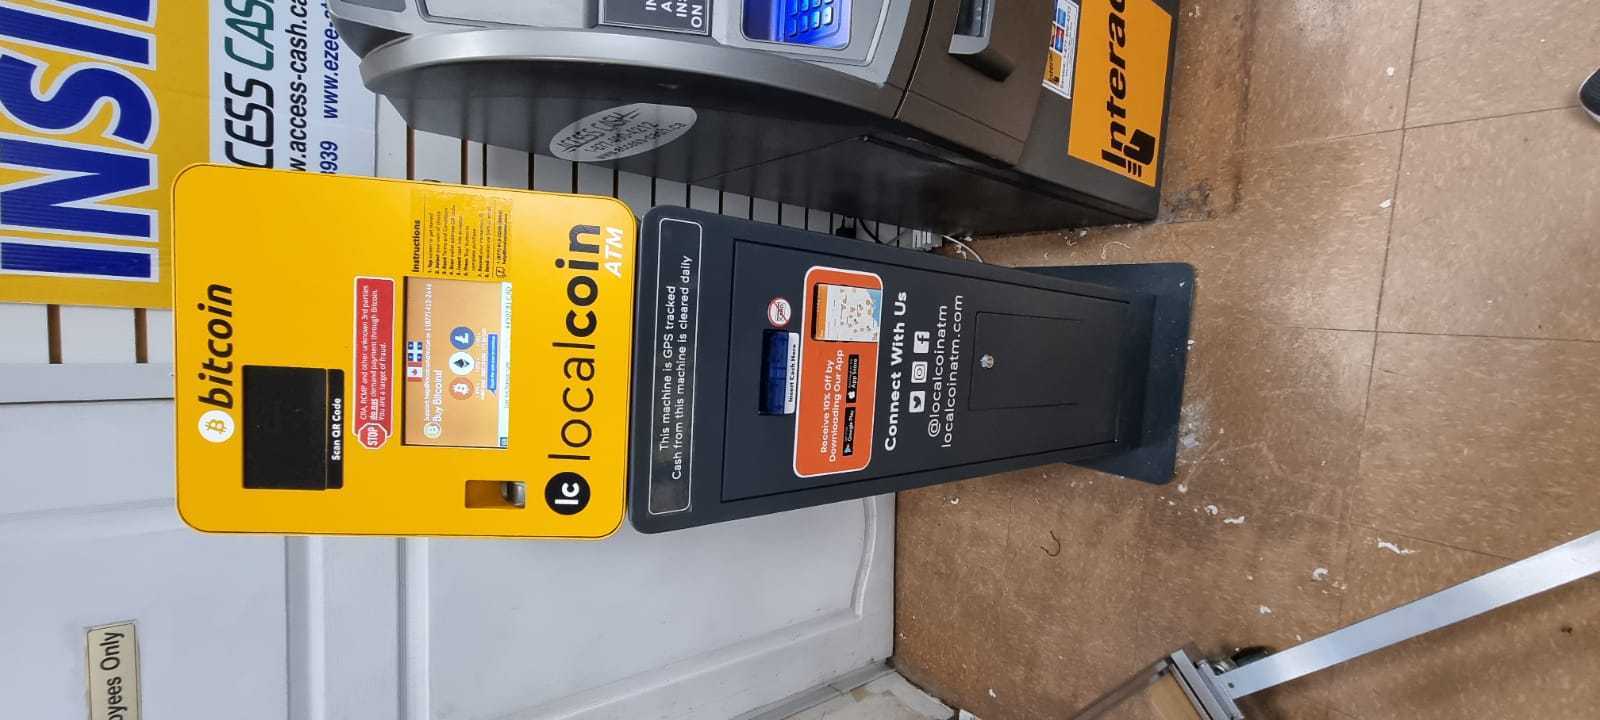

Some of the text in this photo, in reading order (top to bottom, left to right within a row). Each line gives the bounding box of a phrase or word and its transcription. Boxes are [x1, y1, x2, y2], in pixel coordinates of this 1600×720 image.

[676, 0, 688, 17] IN
[691, 4, 703, 28] ON
[224, 0, 274, 71] CAS
[0, 0, 158, 282] INSI
[412, 220, 420, 272] Instructions
[604, 226, 624, 278] ATM
[362, 286, 370, 307] parties
[198, 283, 233, 409] bitcoin
[370, 314, 379, 340] through
[379, 342, 387, 362] fraud.
[548, 224, 600, 461] localcoin
[370, 341, 379, 370] payment
[380, 371, 388, 390] target
[659, 286, 676, 451] This machine is GPS tracked
[672, 256, 693, 480] Cash from this machine is cleared daily
[884, 291, 907, 451] Connect With Us
[928, 305, 948, 437] @localcoinatm
[941, 295, 964, 448] localcoinatm.com
[331, 398, 342, 460] Scan QR Code
[370, 410, 377, 420] do
[433, 407, 443, 422] Buy
[820, 360, 834, 453] Receive 10% Off by
[828, 350, 845, 462] Downloading Our App
[367, 426, 378, 446] STOP
[554, 482, 580, 506] lc
[99, 632, 124, 670] Only
